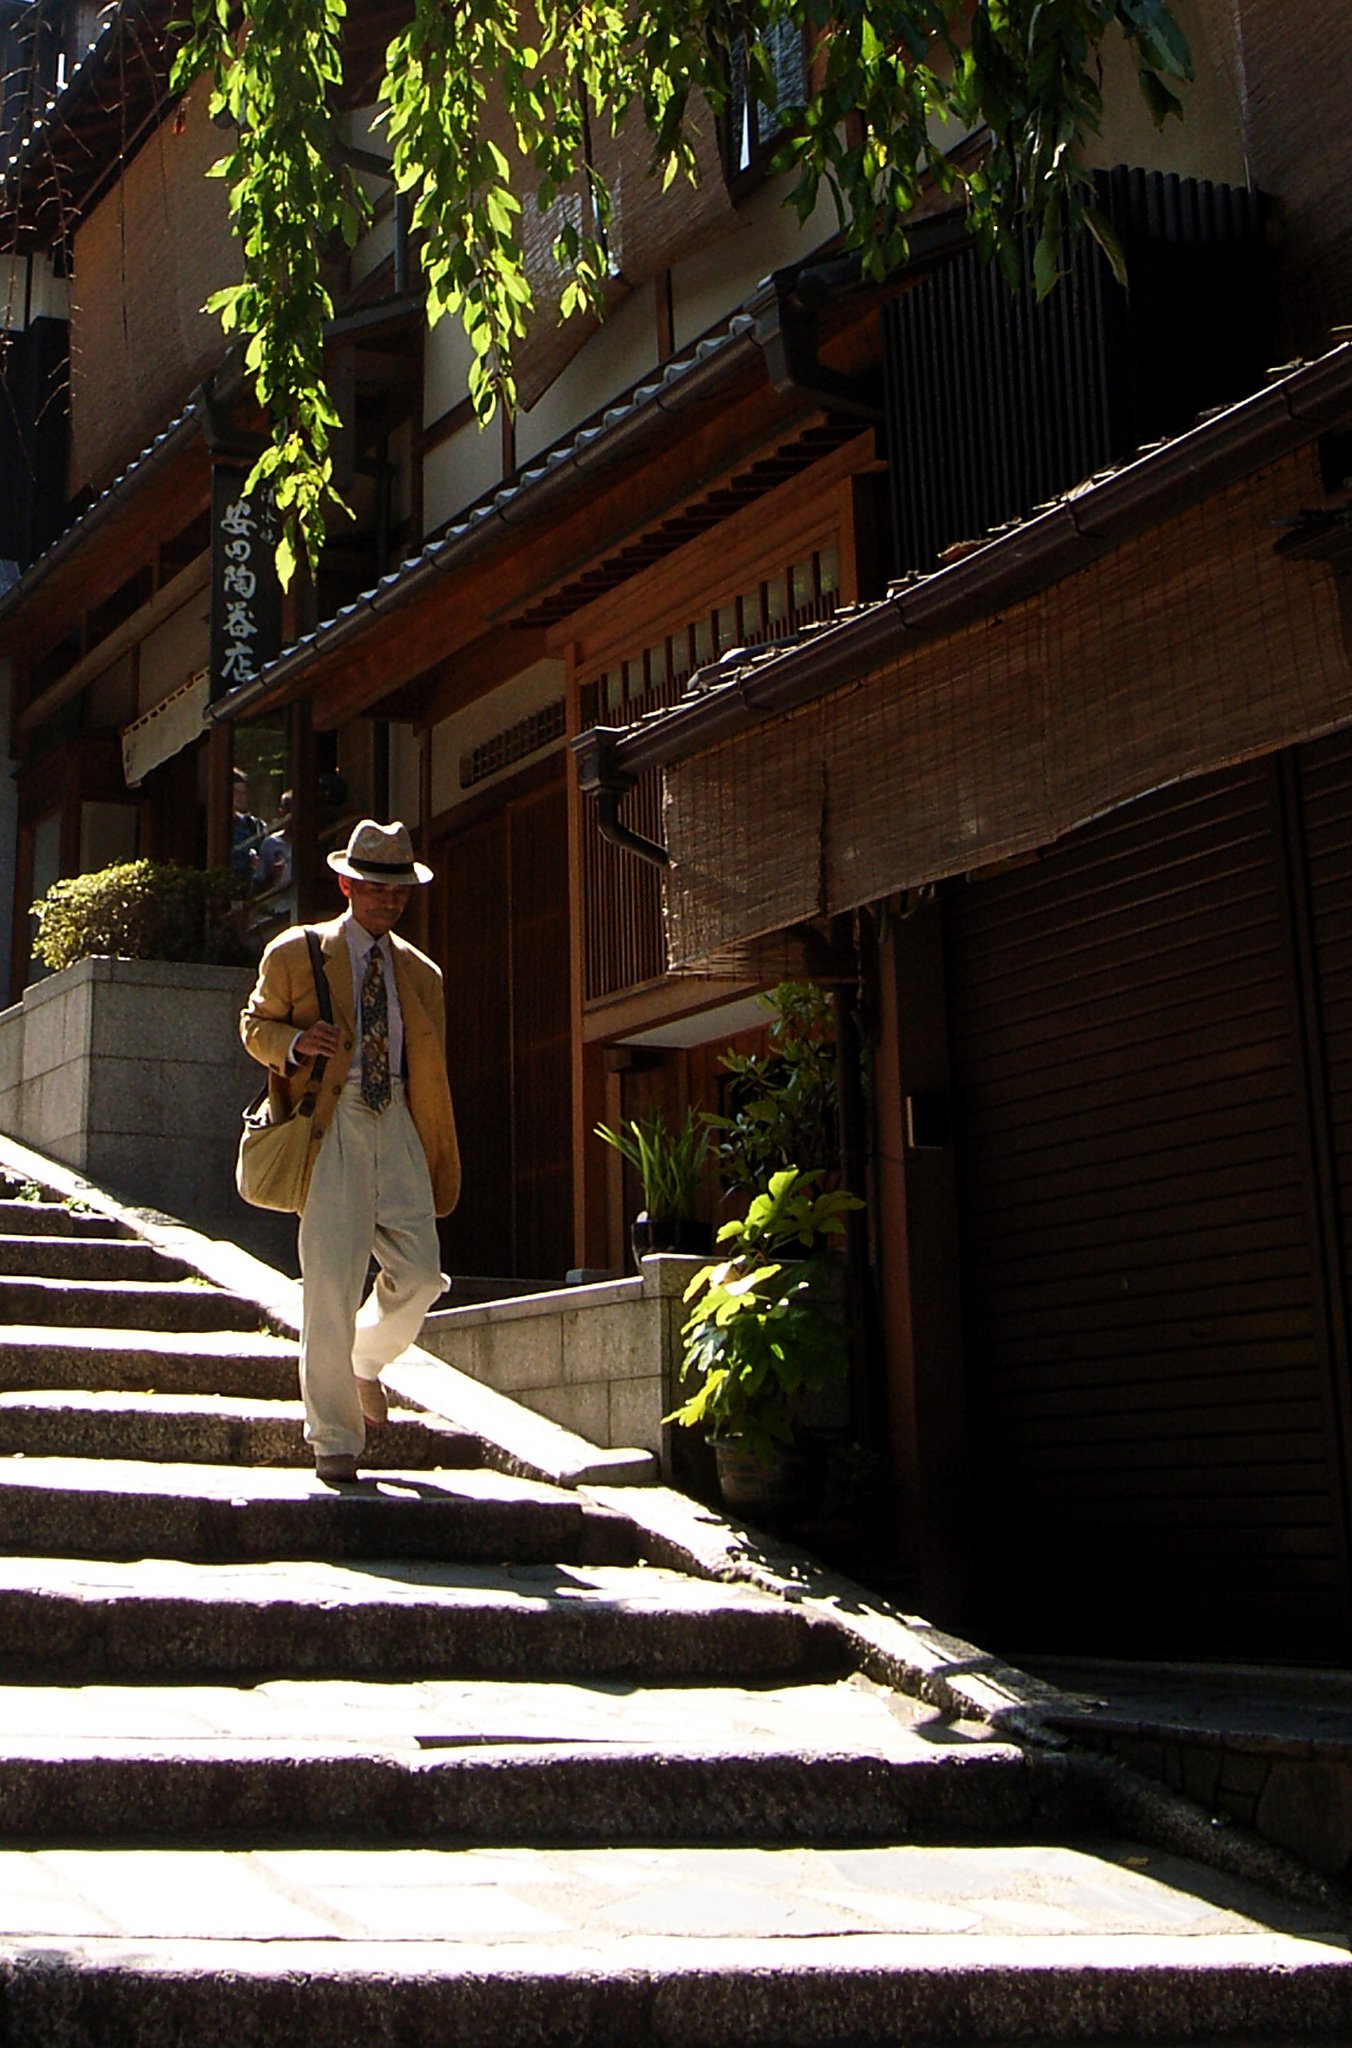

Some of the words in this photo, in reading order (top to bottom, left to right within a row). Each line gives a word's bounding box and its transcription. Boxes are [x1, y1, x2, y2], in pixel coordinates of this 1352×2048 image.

[220, 500, 258, 683] 安田陶器店
